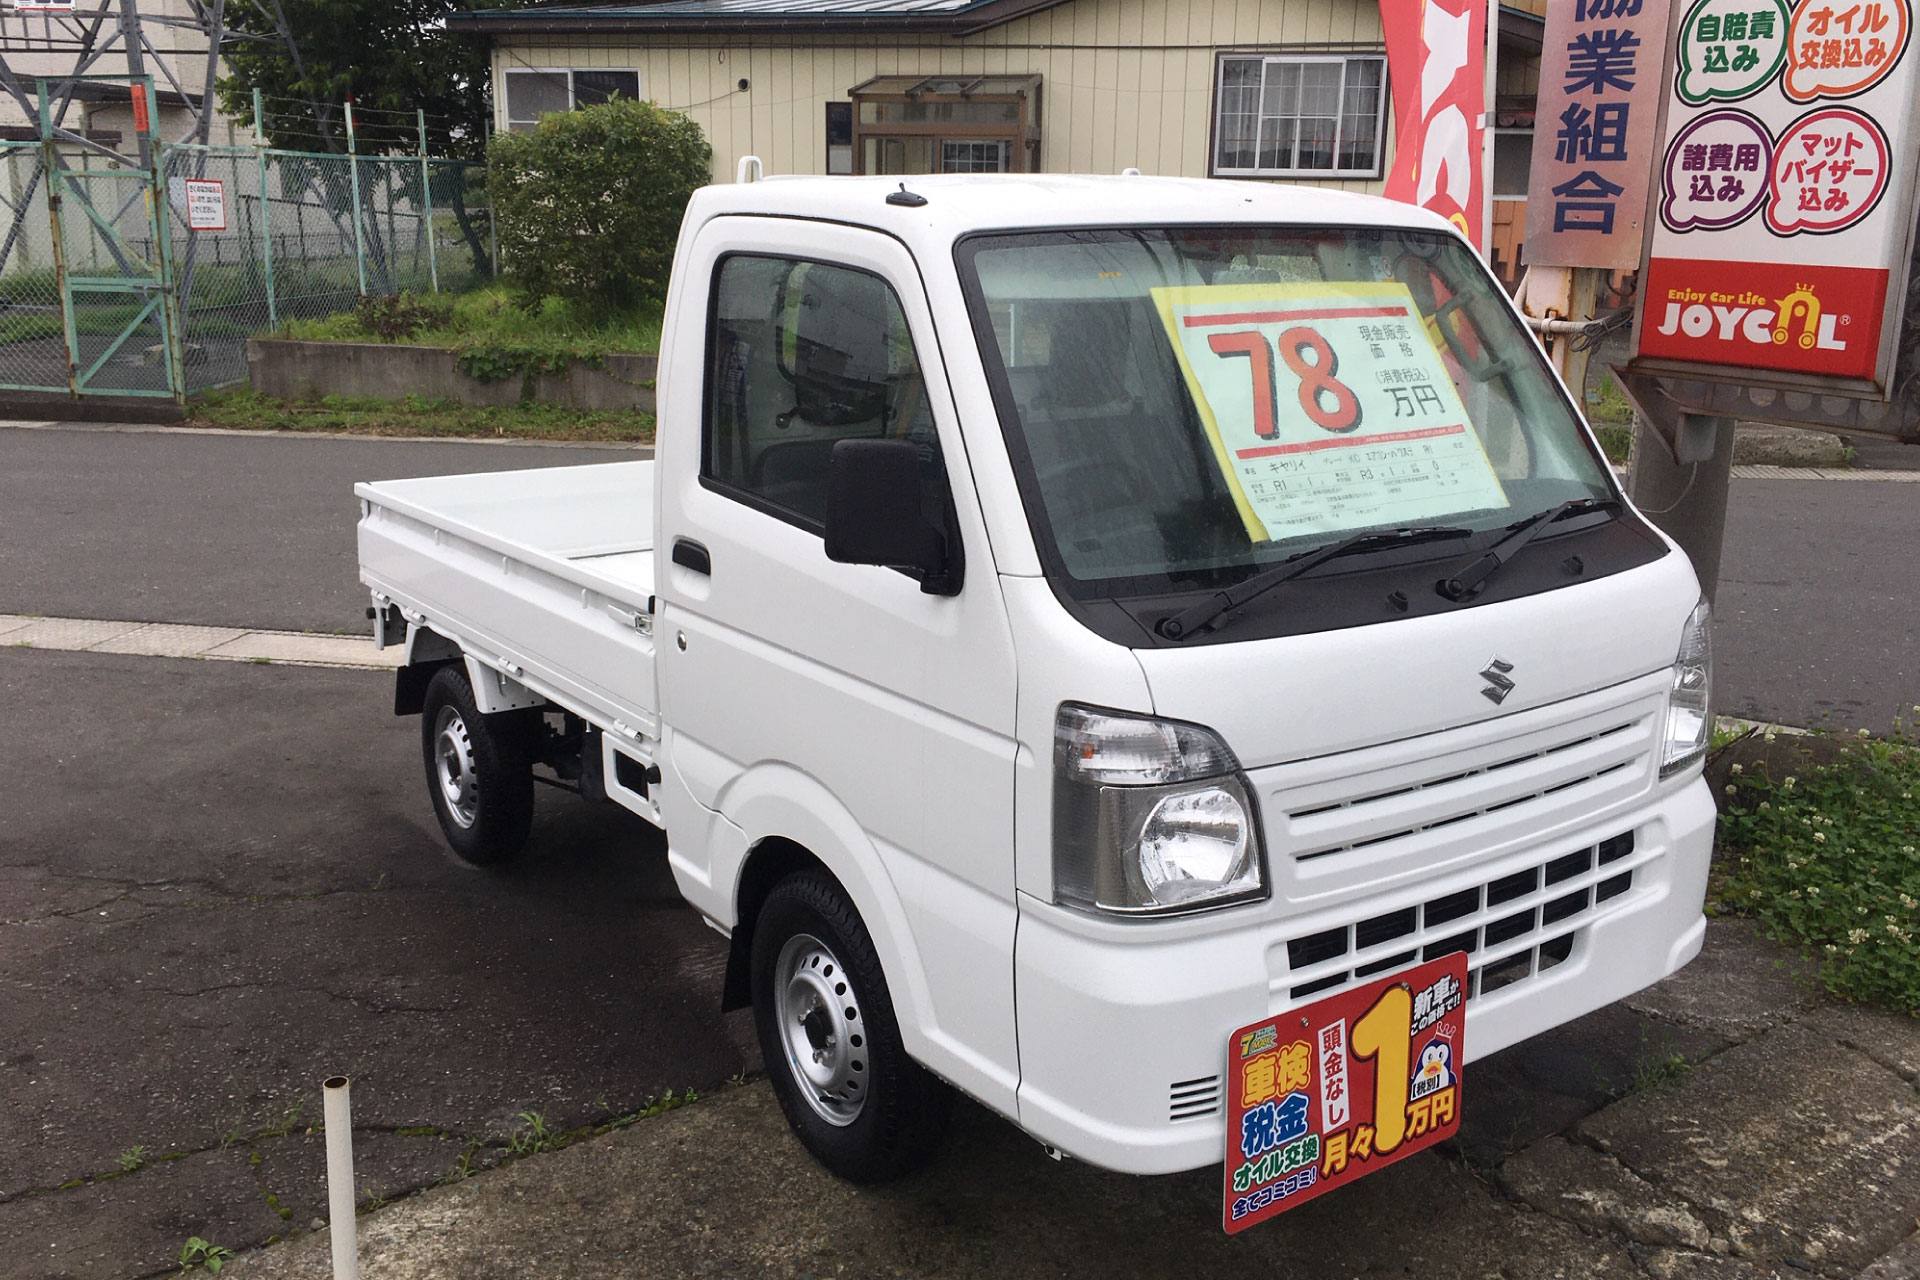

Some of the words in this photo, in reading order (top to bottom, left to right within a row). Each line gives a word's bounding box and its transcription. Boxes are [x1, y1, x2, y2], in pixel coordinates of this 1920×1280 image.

[1697, 10, 1776, 42] 自賠責
[1807, 7, 1888, 35] オイル
[1702, 45, 1760, 73] 込み
[1800, 38, 1887, 70] 交換込み
[1681, 143, 1760, 172] 諸費用
[1800, 132, 1864, 156] マット
[1781, 159, 1874, 184] バイザー
[1688, 175, 1745, 202] 込み
[1798, 187, 1849, 212] 込み
[1668, 287, 1706, 303] Enjoy
[1710, 292, 1735, 303] Car
[1738, 291, 1767, 306] Life
[1359, 324, 1411, 344] 現金販売
[1208, 327, 1363, 440] 78
[1384, 385, 1446, 417] 万円
[1242, 1040, 1312, 1108] 車検
[1323, 1024, 1344, 1125] 頭金なし
[1242, 1092, 1309, 1158] 税金
[1233, 1133, 1320, 1191] オイル交換
[1232, 1167, 1317, 1220] 全てコミコミ!
